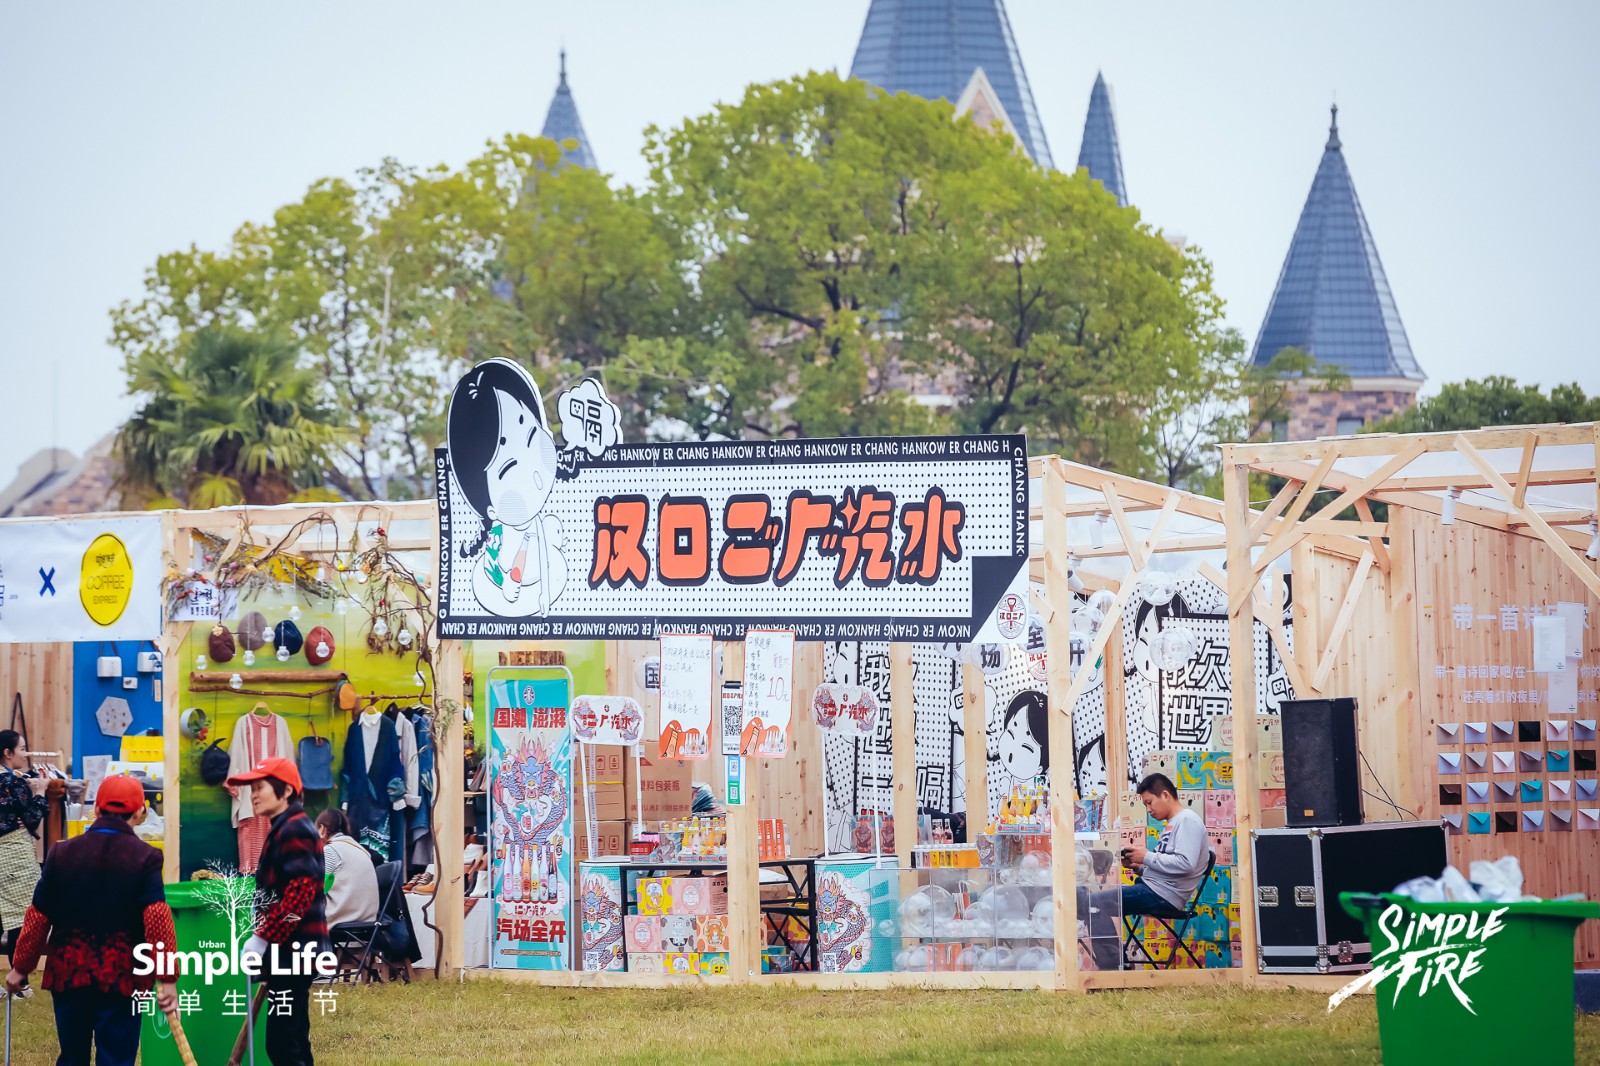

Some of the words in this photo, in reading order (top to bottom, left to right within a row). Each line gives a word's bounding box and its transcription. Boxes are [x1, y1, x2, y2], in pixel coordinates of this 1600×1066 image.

[620, 448, 660, 462] HANKOW
[663, 447, 674, 460] ER
[676, 446, 709, 460] CHANG
[712, 445, 753, 459] HANKOW
[756, 444, 767, 458] ER
[769, 443, 801, 458] CHANG
[804, 443, 848, 457] HANKOW
[851, 442, 862, 456] ER
[864, 441, 899, 456] CHANG
[901, 440, 947, 455] HANKOW
[949, 440, 961, 454] ER
[963, 439, 999, 454] CHANG
[1014, 446, 1025, 503] CHANG
[436, 457, 448, 510] CHANG
[441, 514, 449, 531] ER
[588, 486, 965, 590] 汉口二厂汽水
[439, 541, 449, 603] HANKOW
[441, 622, 466, 635] CHAN
[467, 622, 477, 635] ER
[478, 622, 518, 635] HANKOW
[519, 622, 550, 635] CHANG
[552, 622, 563, 635] ER
[564, 622, 606, 636] HANKOW
[607, 622, 639, 636] CHANG
[641, 622, 651, 636] ER
[700, 623, 733, 636] CHANG
[735, 623, 745, 636] ER
[824, 623, 835, 637] ER
[837, 623, 881, 637] HANKOW
[883, 623, 919, 637] CHANG
[922, 624, 934, 637] ER
[493, 707, 527, 729] 国潮
